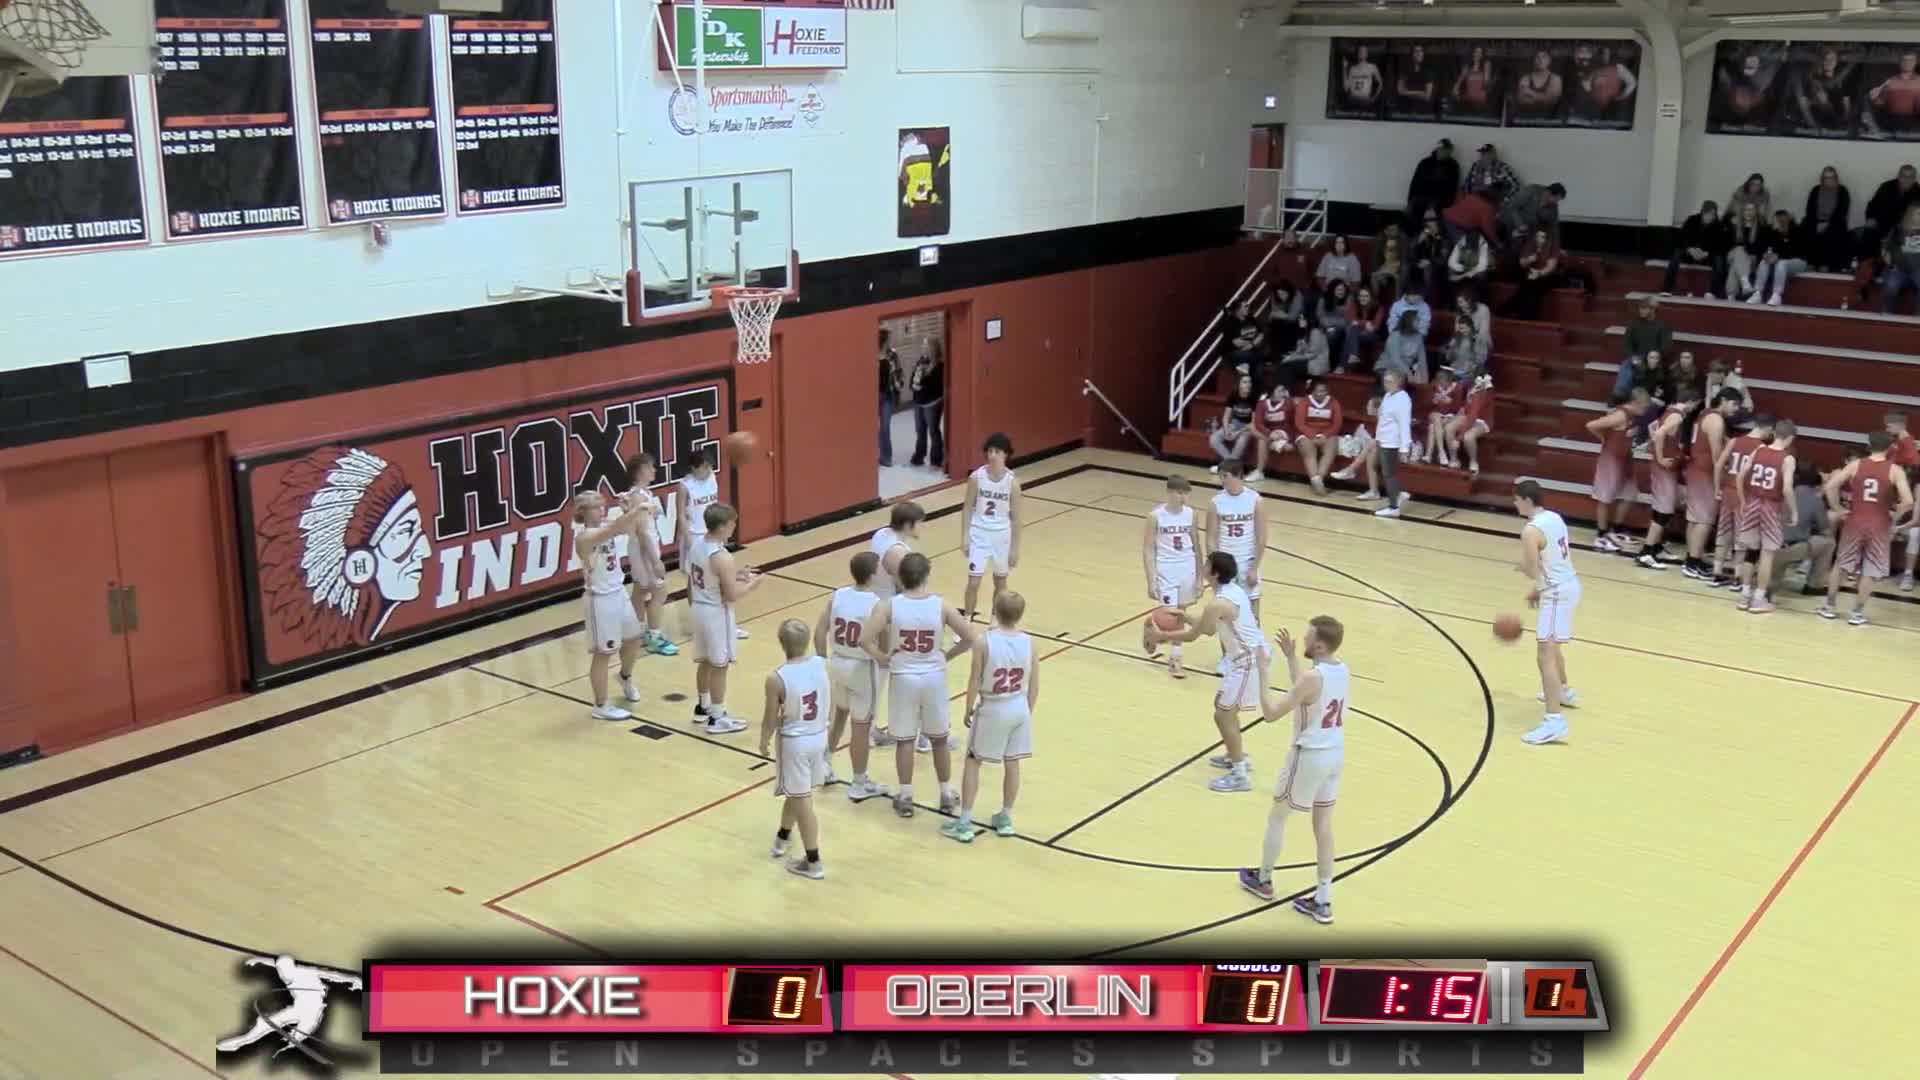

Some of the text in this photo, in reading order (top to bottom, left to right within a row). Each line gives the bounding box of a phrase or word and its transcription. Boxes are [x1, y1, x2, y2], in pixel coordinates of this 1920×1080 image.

[771, 19, 826, 55] HOXIE
[796, 46, 841, 55] FEEDYARD
[352, 199, 391, 216] HOXIE
[391, 195, 442, 212] INDIANS
[482, 188, 516, 205] HOXIE
[517, 185, 561, 201] INDIANS
[199, 211, 242, 229] HOXIE
[243, 206, 300, 224] INDIANS
[24, 224, 75, 243] HOXIE
[75, 219, 143, 239] INDIANS
[430, 386, 722, 541] HOXIE
[1750, 463, 1777, 490] 23
[1863, 478, 1879, 502] 2
[984, 501, 996, 516] 2
[1227, 523, 1245, 538] 15
[833, 616, 862, 649] 20
[899, 629, 936, 654] 35
[992, 667, 1025, 695] 22
[802, 690, 819, 722] 3
